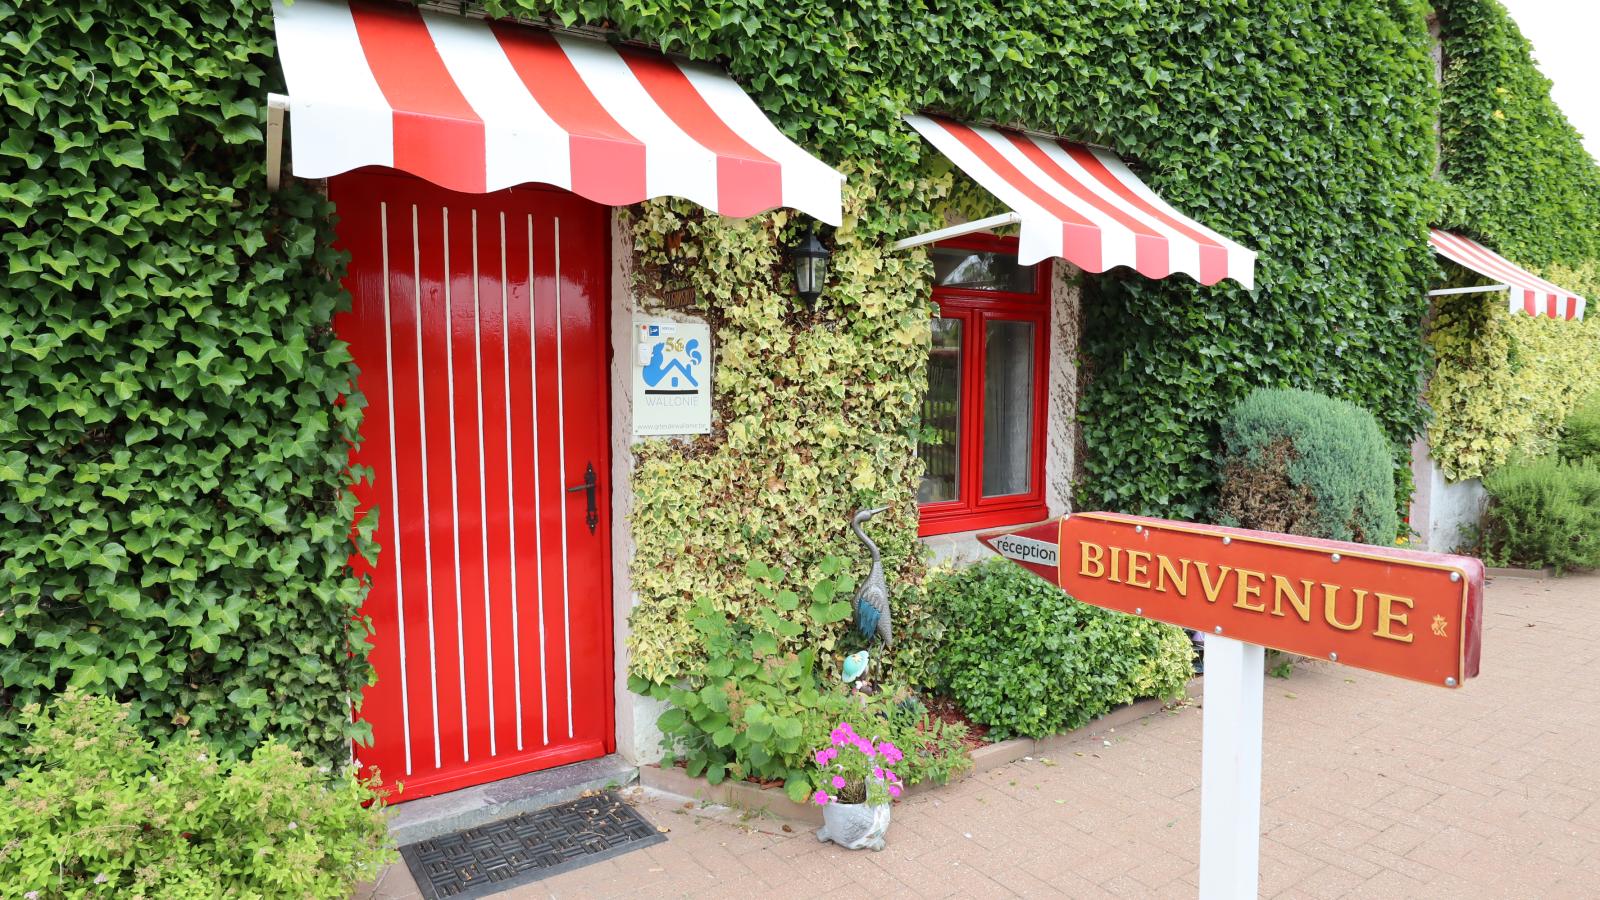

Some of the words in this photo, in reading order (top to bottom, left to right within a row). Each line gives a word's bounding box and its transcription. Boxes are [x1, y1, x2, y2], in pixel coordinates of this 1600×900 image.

[646, 396, 699, 407] WALLONIE
[996, 537, 1056, 562] réception
[1078, 541, 1415, 644] BIENVENUE
